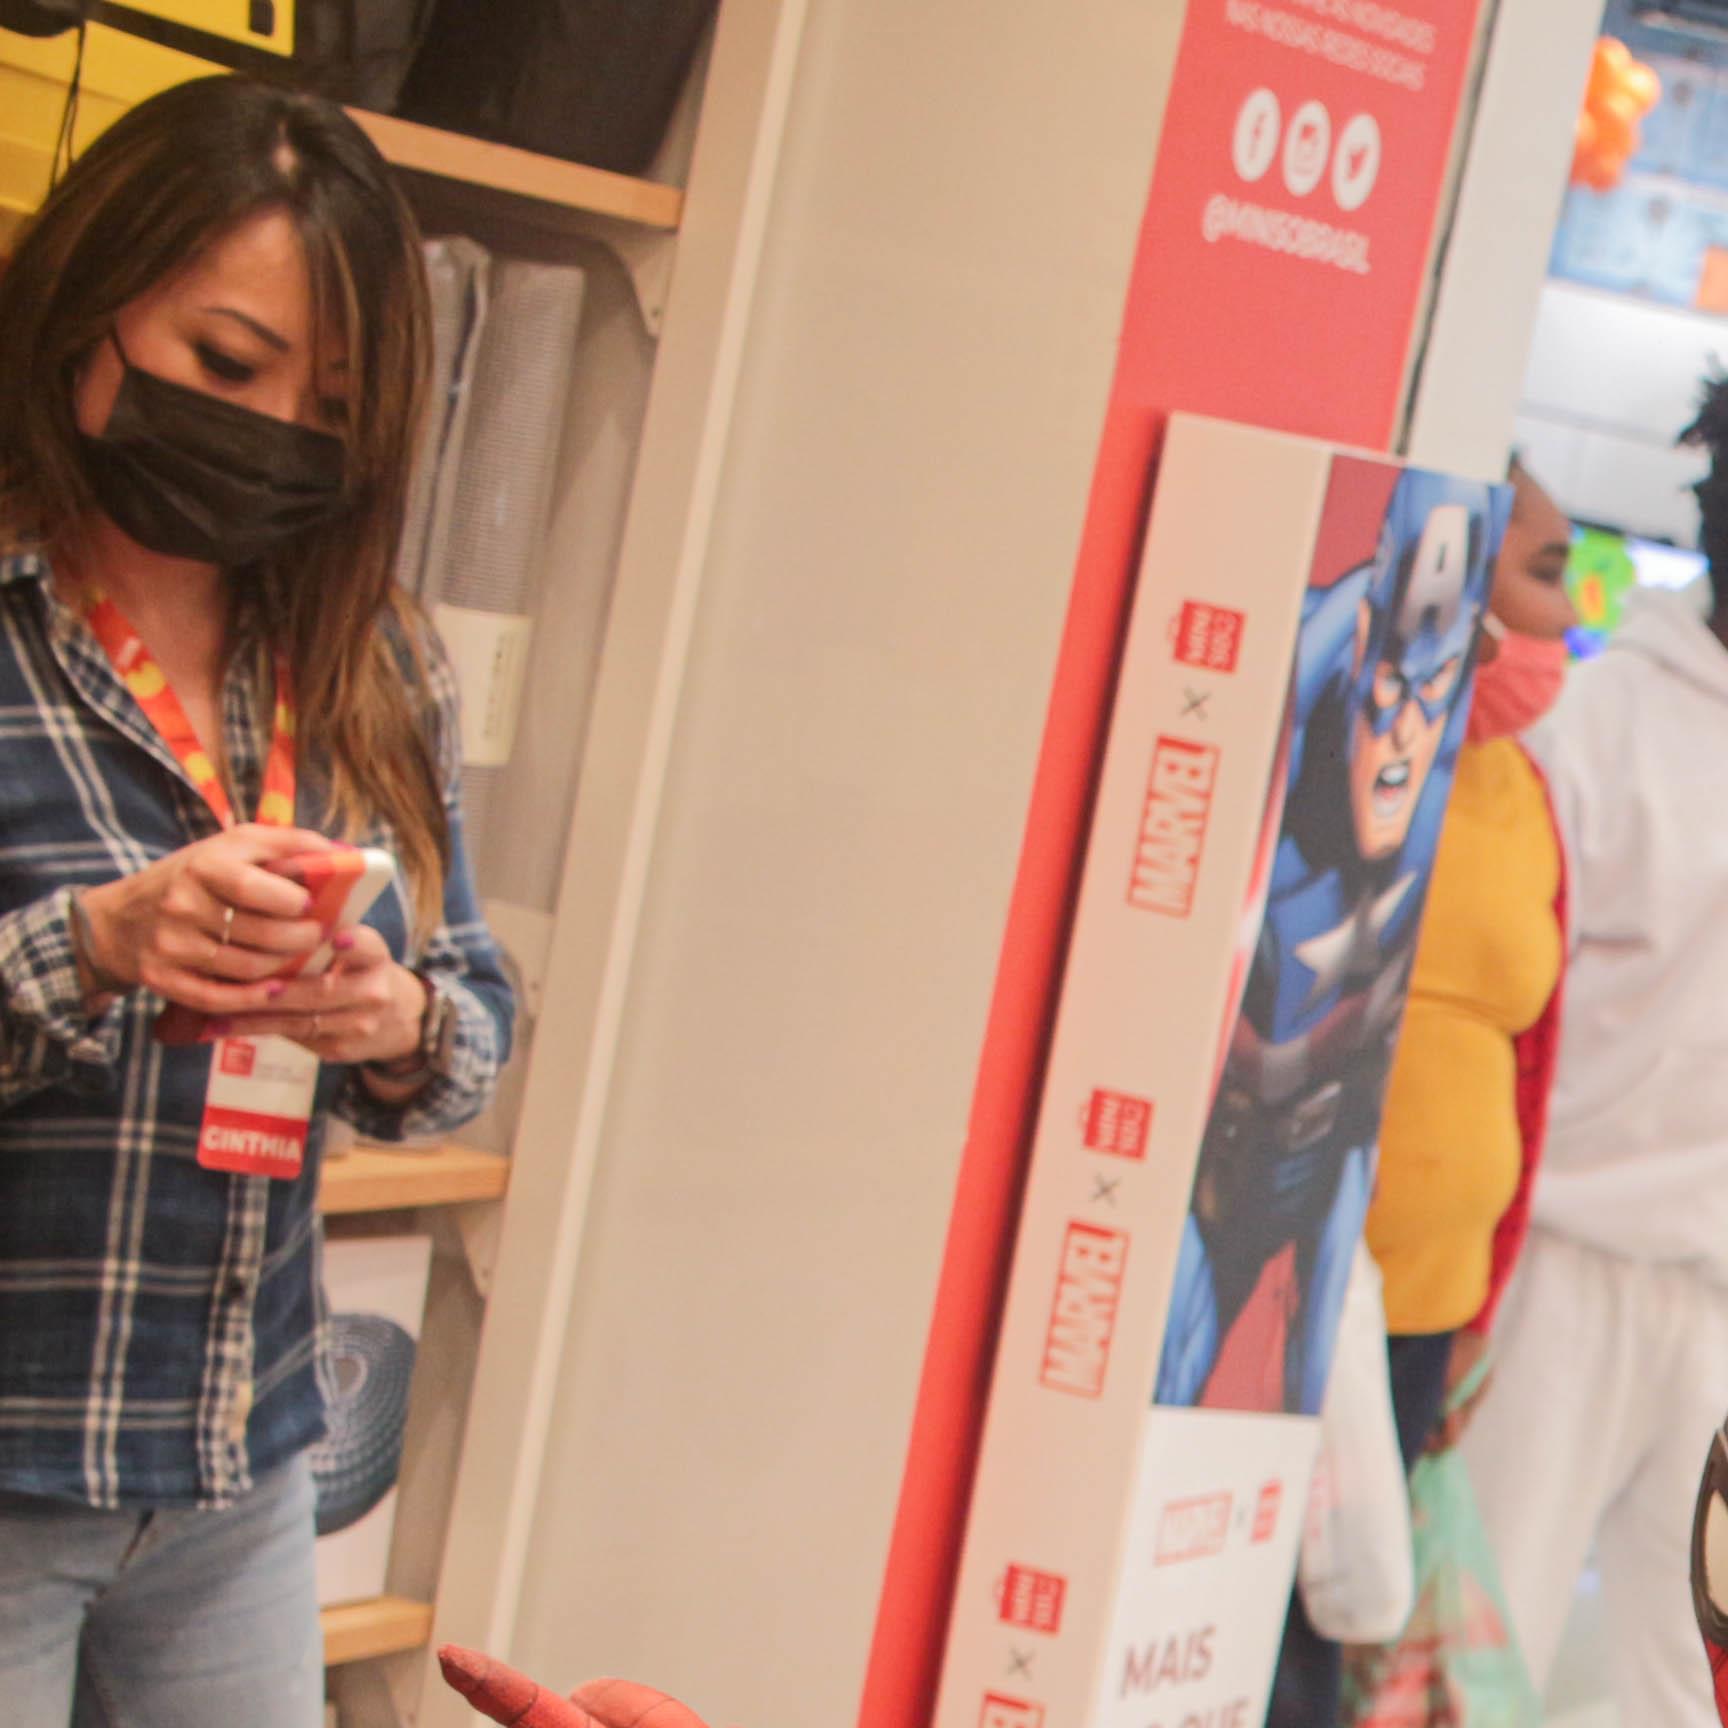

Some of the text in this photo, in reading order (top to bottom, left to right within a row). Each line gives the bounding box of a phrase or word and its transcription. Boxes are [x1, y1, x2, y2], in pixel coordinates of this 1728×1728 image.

[1128, 734, 1221, 918] MARVEL
[204, 1124, 301, 1164] CINTHIA
[1040, 1220, 1129, 1398] MARVEL
[1118, 1624, 1217, 1699] MAIS
